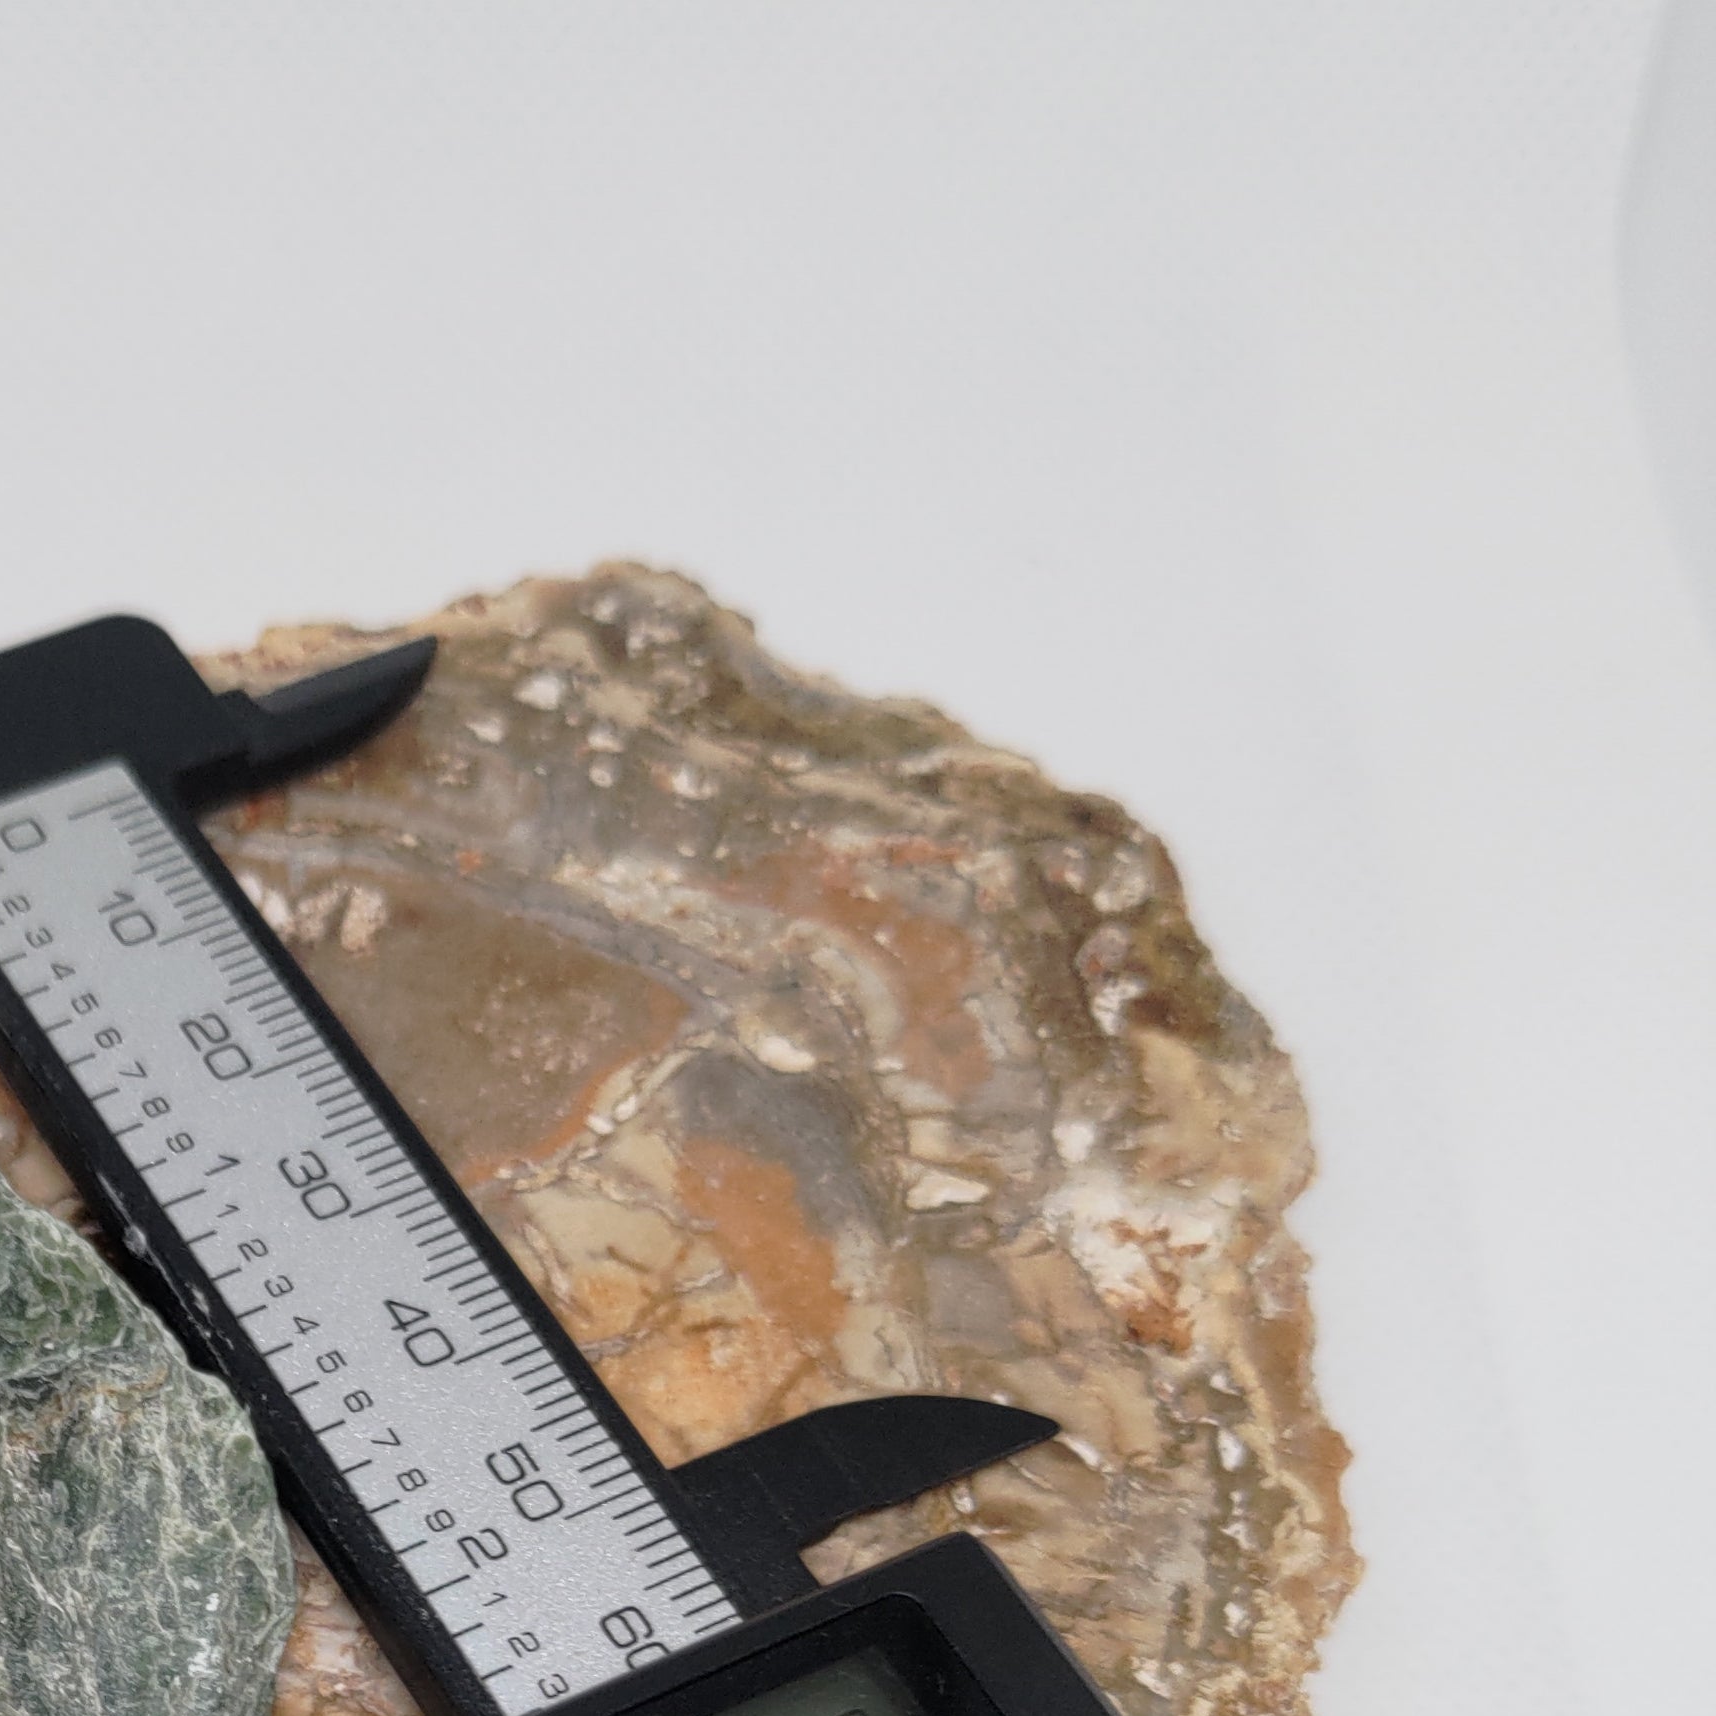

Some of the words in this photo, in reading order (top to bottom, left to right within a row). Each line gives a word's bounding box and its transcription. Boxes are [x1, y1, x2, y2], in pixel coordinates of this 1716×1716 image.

[2, 894, 32, 916] 2
[25, 927, 54, 950] 3
[51, 960, 77, 982] 4
[71, 992, 100, 1016] 5
[95, 1026, 124, 1049] 6
[119, 1061, 149, 1085] 7
[142, 1096, 171, 1120] 8
[166, 1131, 196, 1155] 9
[0, 817, 47, 854] 0
[98, 888, 158, 947] 10
[179, 1013, 253, 1082] 20
[278, 1150, 353, 1222] 30
[383, 1298, 456, 1369] 40
[484, 1441, 565, 1524] 50
[204, 1153, 242, 1178] 1
[216, 1202, 242, 1219] 1
[237, 1237, 269, 1263] 2
[264, 1273, 295, 1299] 3
[291, 1311, 321, 1336] 4
[315, 1349, 348, 1375] 5
[343, 1388, 374, 1414] 6
[370, 1426, 402, 1454] 7
[397, 1467, 429, 1493] 8
[425, 1508, 457, 1534] 9
[456, 1527, 510, 1570] 2
[480, 1590, 509, 1609] 1
[506, 1630, 542, 1659] 2
[537, 1672, 571, 1700] 3
